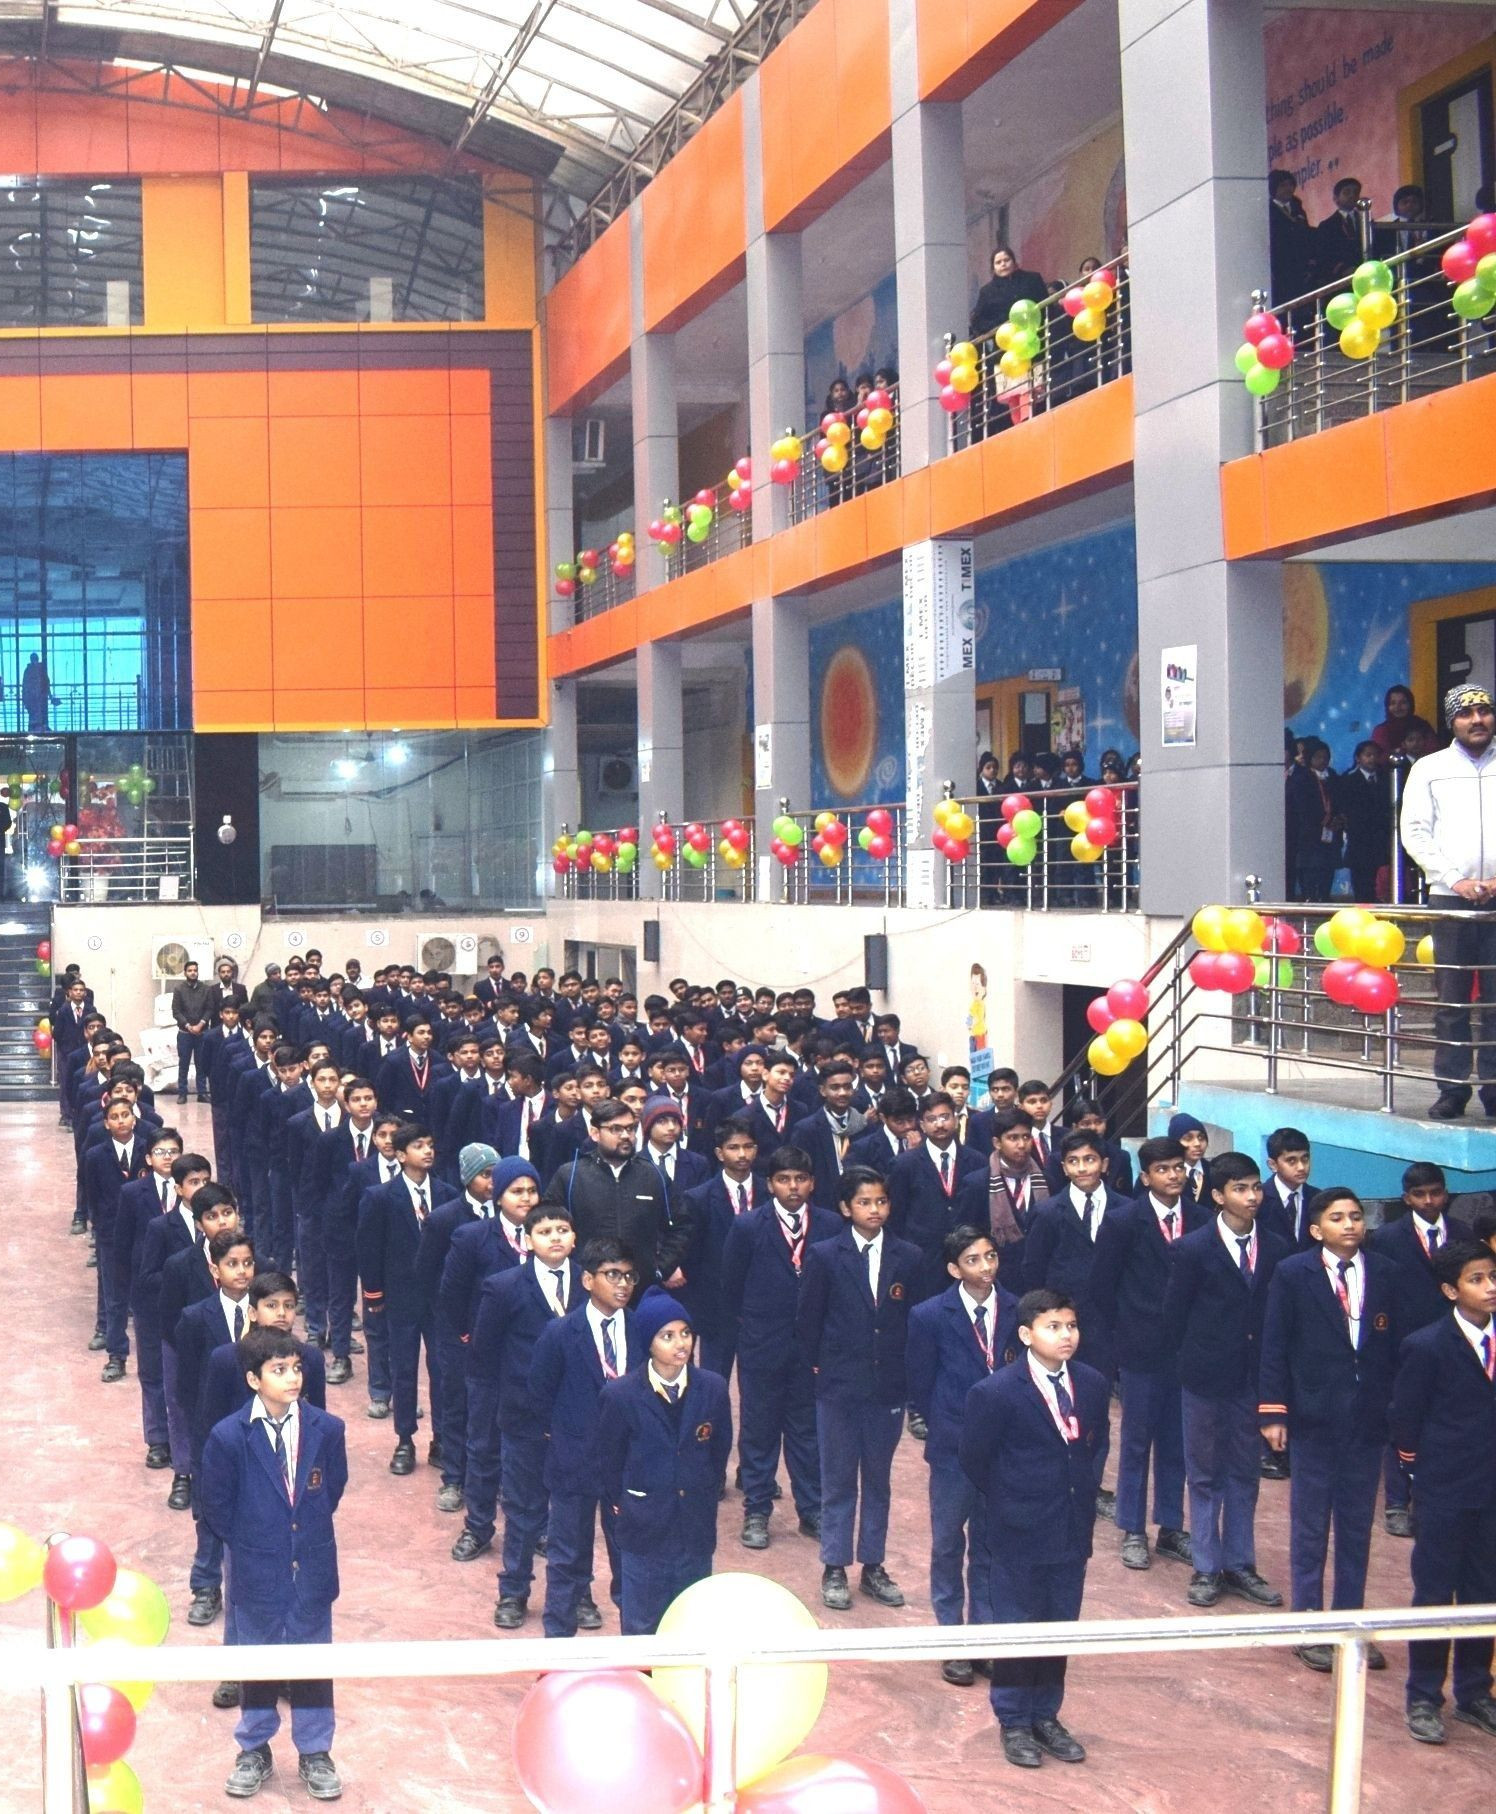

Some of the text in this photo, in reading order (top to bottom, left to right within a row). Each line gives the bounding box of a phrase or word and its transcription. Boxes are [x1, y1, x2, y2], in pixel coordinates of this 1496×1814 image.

[1298, 61, 1337, 106] should
[1342, 55, 1358, 80] be
[1362, 34, 1395, 67] made
[1285, 130, 1299, 153] as
